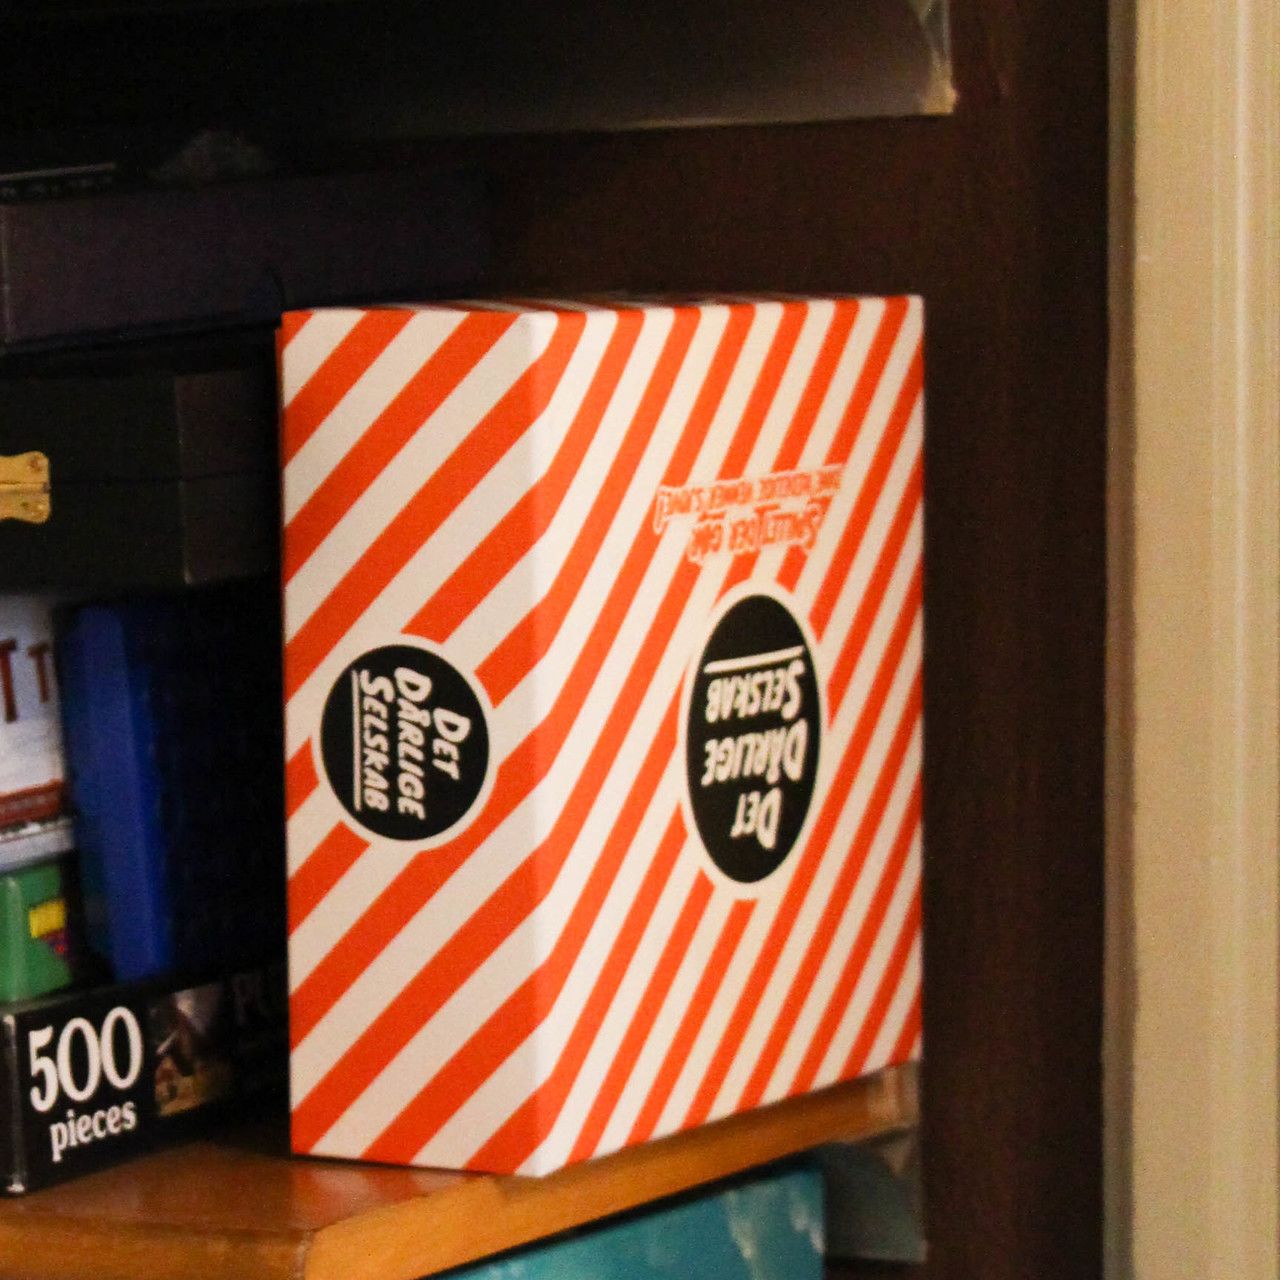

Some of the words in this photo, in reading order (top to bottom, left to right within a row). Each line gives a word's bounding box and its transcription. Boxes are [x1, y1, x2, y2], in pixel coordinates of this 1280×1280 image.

[705, 655, 805, 723] SELSKAB
[360, 669, 396, 813] SELSKAB
[394, 666, 433, 820] DÅRLIGE
[432, 707, 472, 781] DET
[700, 718, 809, 788] DÅRLIGE
[729, 786, 782, 851] DET
[28, 1006, 143, 1113] 500
[48, 1096, 137, 1164] pieces
